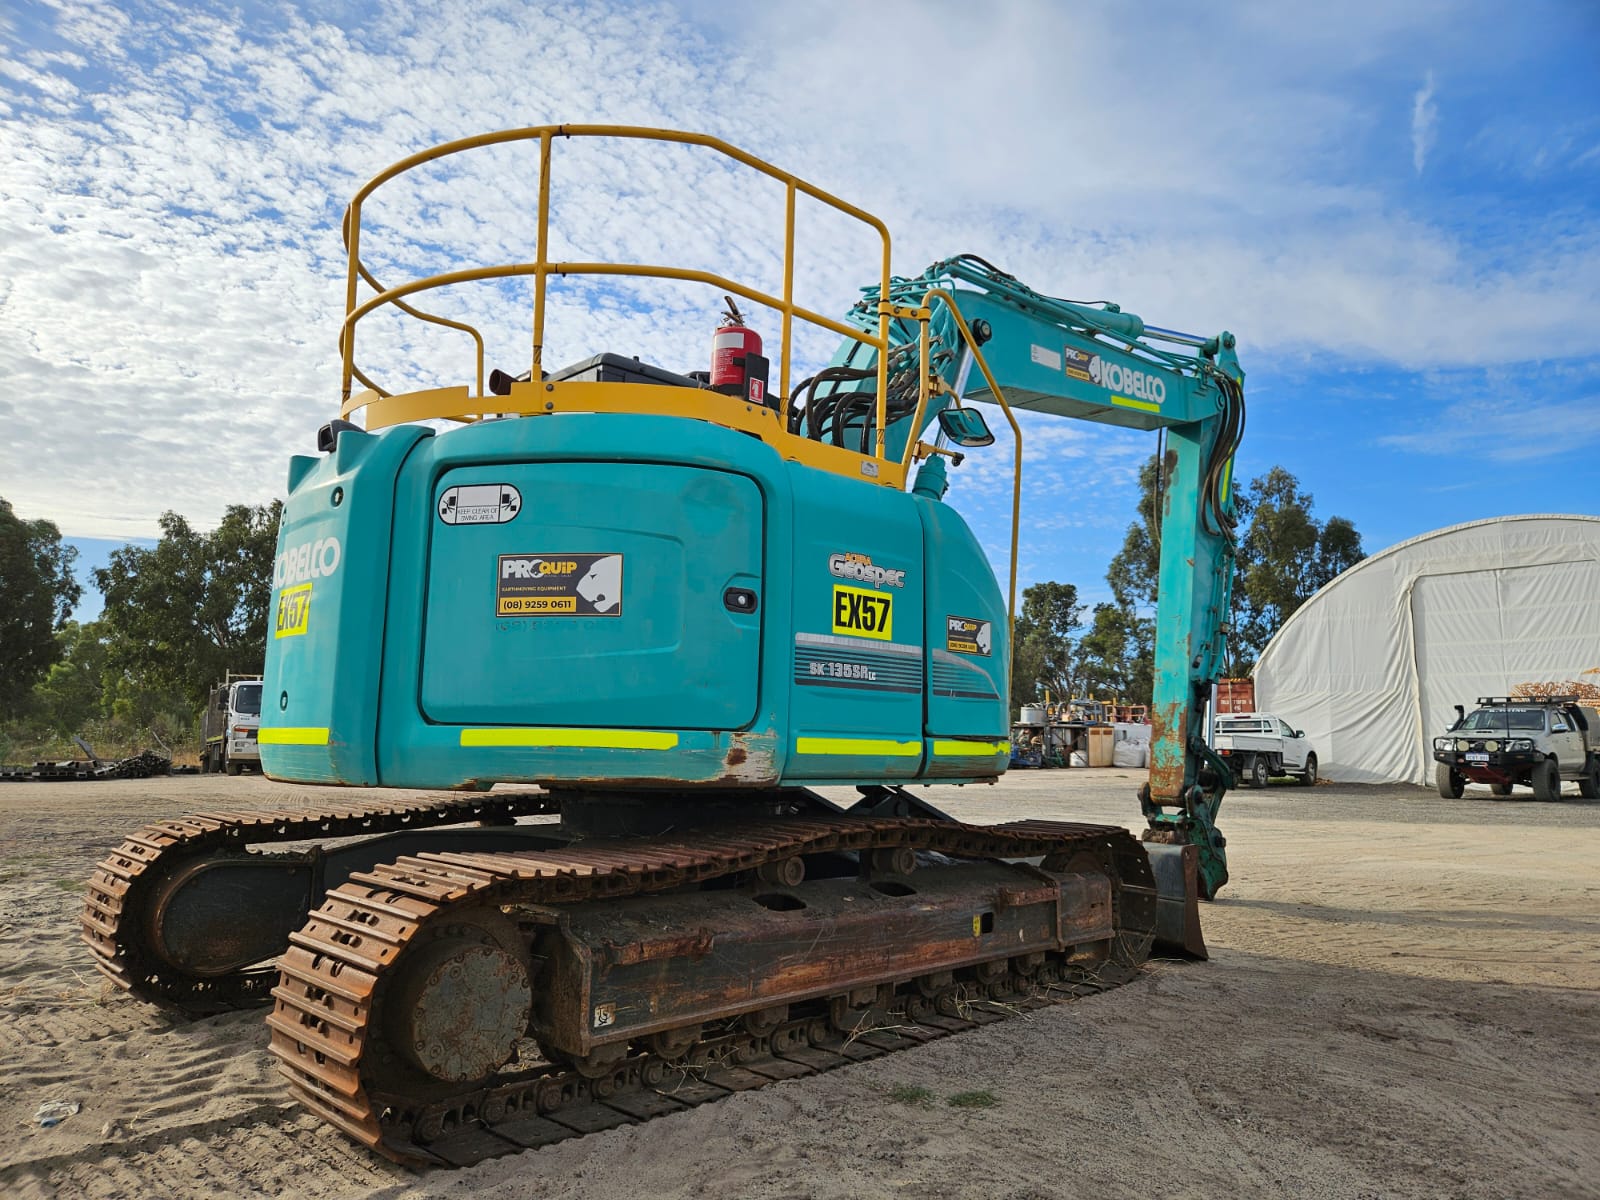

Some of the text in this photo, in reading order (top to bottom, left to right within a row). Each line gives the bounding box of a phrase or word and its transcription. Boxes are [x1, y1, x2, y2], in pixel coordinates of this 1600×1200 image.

[1101, 360, 1166, 404] KOBELCO
[276, 589, 311, 632] EX57
[503, 600, 571, 610] (08) 9259 0611
[834, 590, 891, 633] EX57
[809, 662, 825, 676] SK
